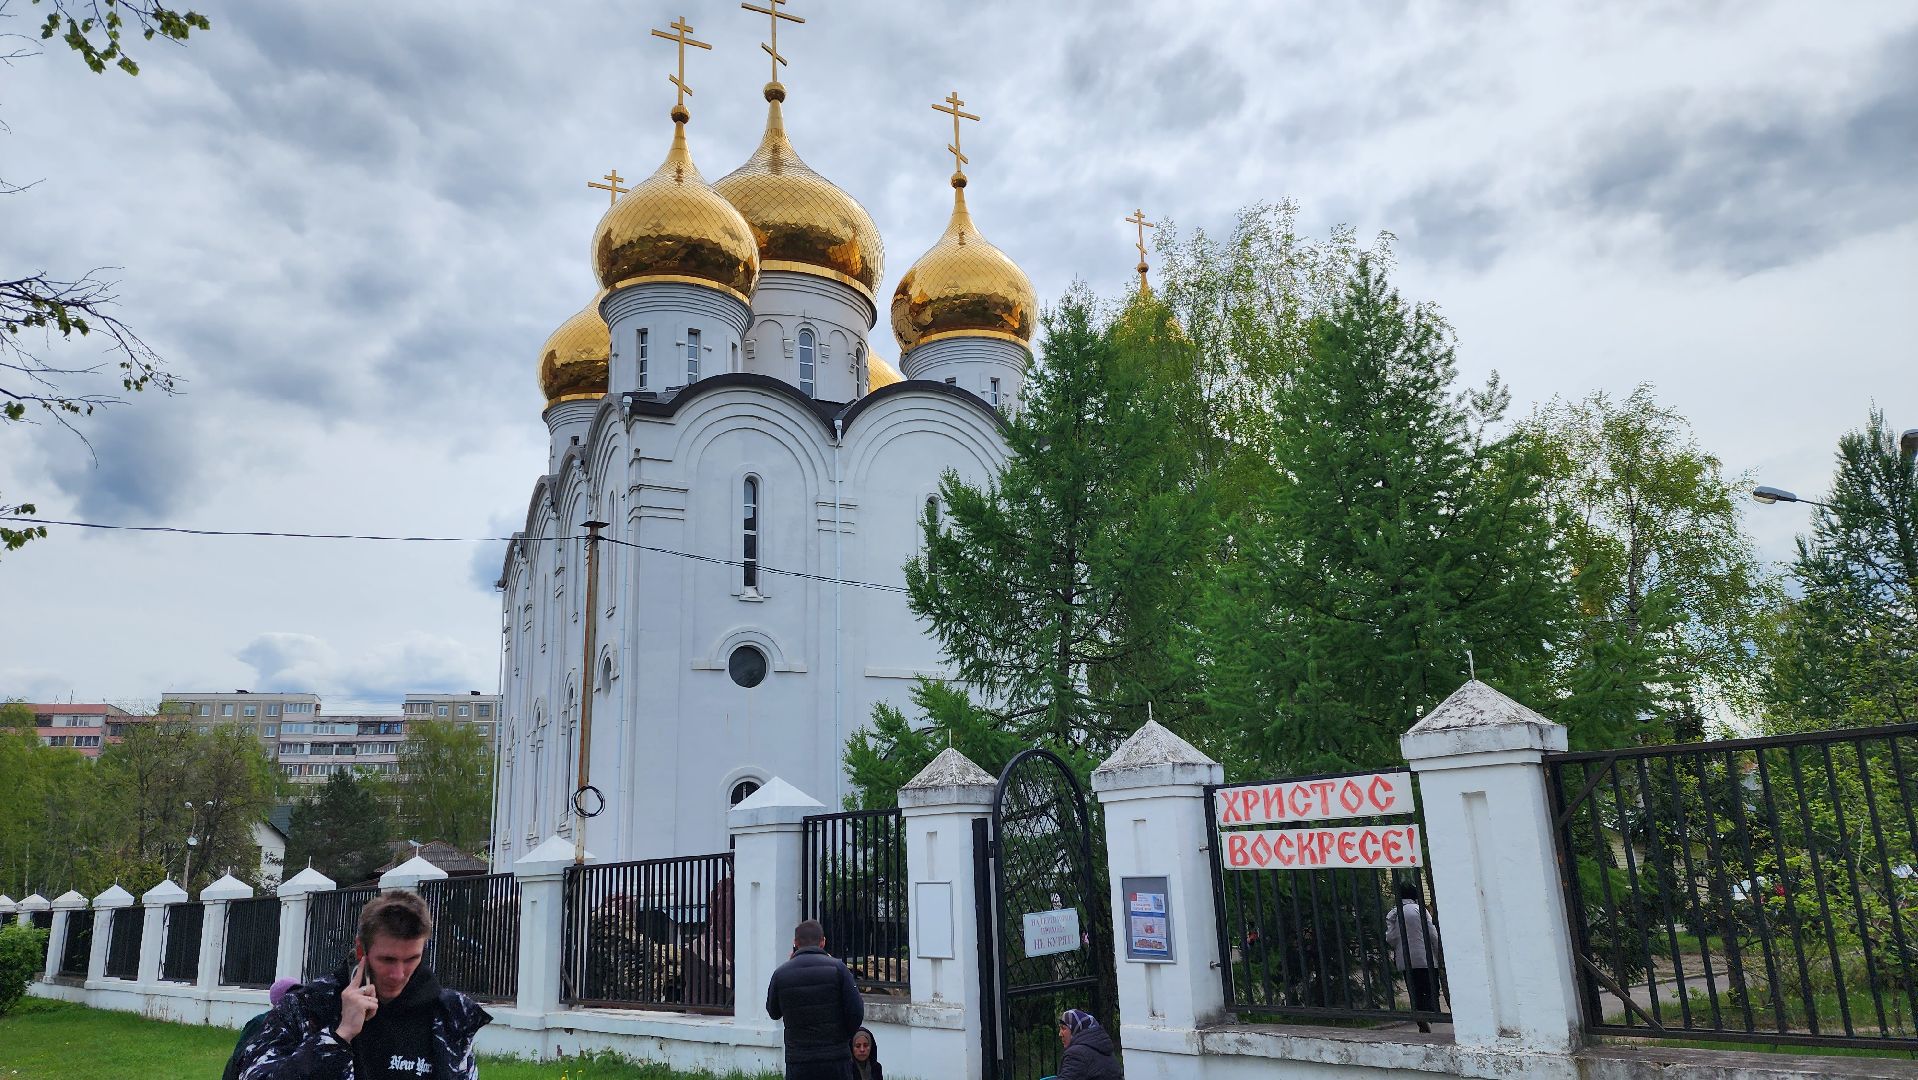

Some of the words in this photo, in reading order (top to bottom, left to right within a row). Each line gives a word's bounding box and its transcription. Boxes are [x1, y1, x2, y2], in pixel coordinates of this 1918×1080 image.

[1220, 775, 1396, 823] ХРИСТОС
[1228, 827, 1417, 867] ВОСКРЕСЕ!
[388, 1055, 415, 1070] New
